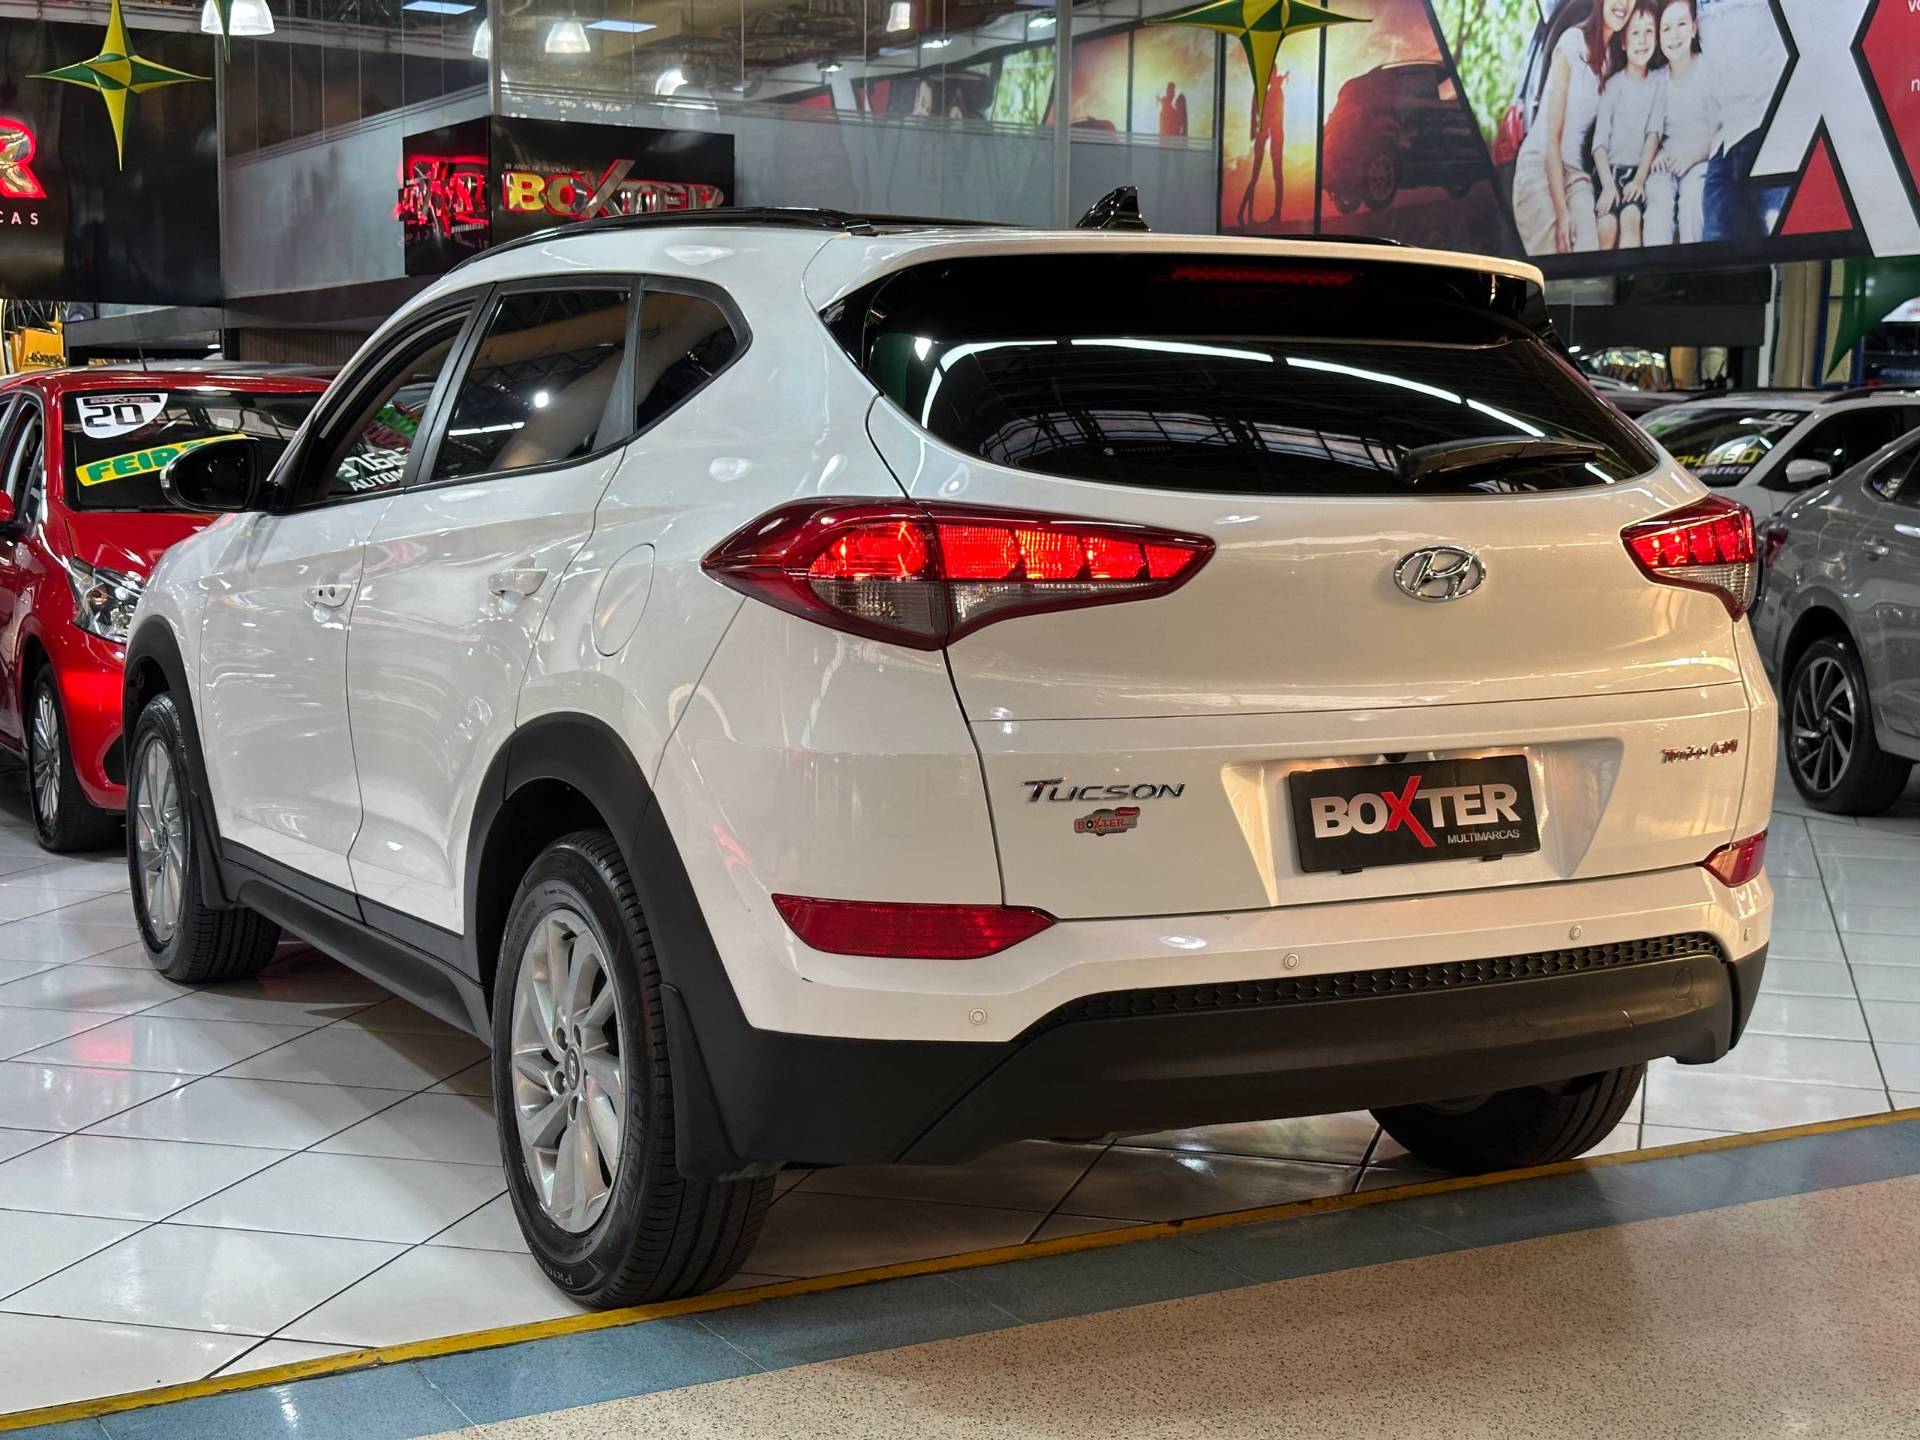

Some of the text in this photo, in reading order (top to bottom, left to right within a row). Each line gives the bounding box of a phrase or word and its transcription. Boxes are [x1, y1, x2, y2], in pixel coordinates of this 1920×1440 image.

[84, 404, 145, 428] 20
[86, 439, 206, 482] FEIR
[1310, 775, 1522, 848] BOXTER
[1076, 816, 1126, 834] BOXTER
[1447, 828, 1521, 845] MULTIMARCAS
